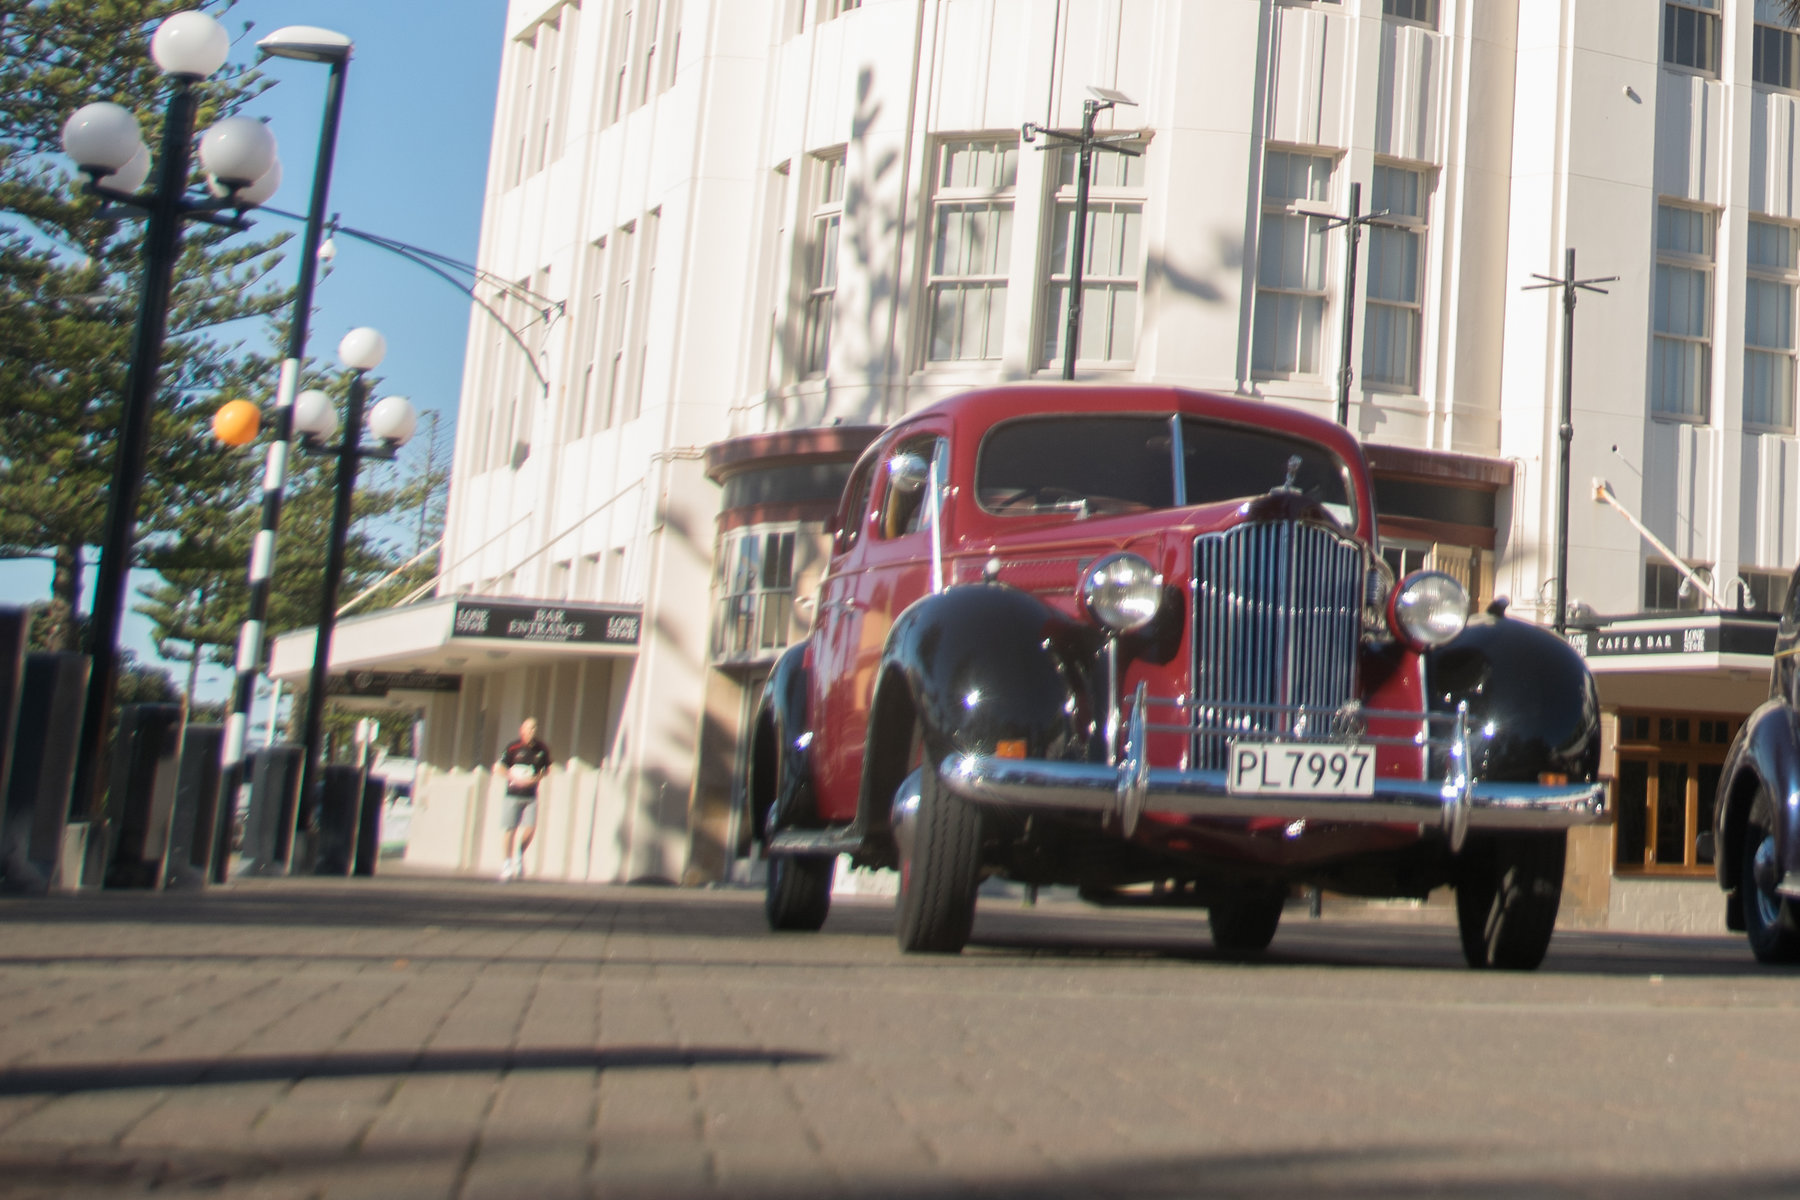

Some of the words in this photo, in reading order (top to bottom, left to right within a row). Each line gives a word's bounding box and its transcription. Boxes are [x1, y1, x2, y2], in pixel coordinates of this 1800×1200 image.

[534, 608, 566, 623] BAR
[508, 619, 585, 636] ENTRANCE
[1684, 629, 1706, 642] LONE
[1597, 636, 1629, 650] CAFE
[1633, 636, 1642, 649] &
[1647, 634, 1672, 648] BAR
[1236, 751, 1370, 788] PL7997
